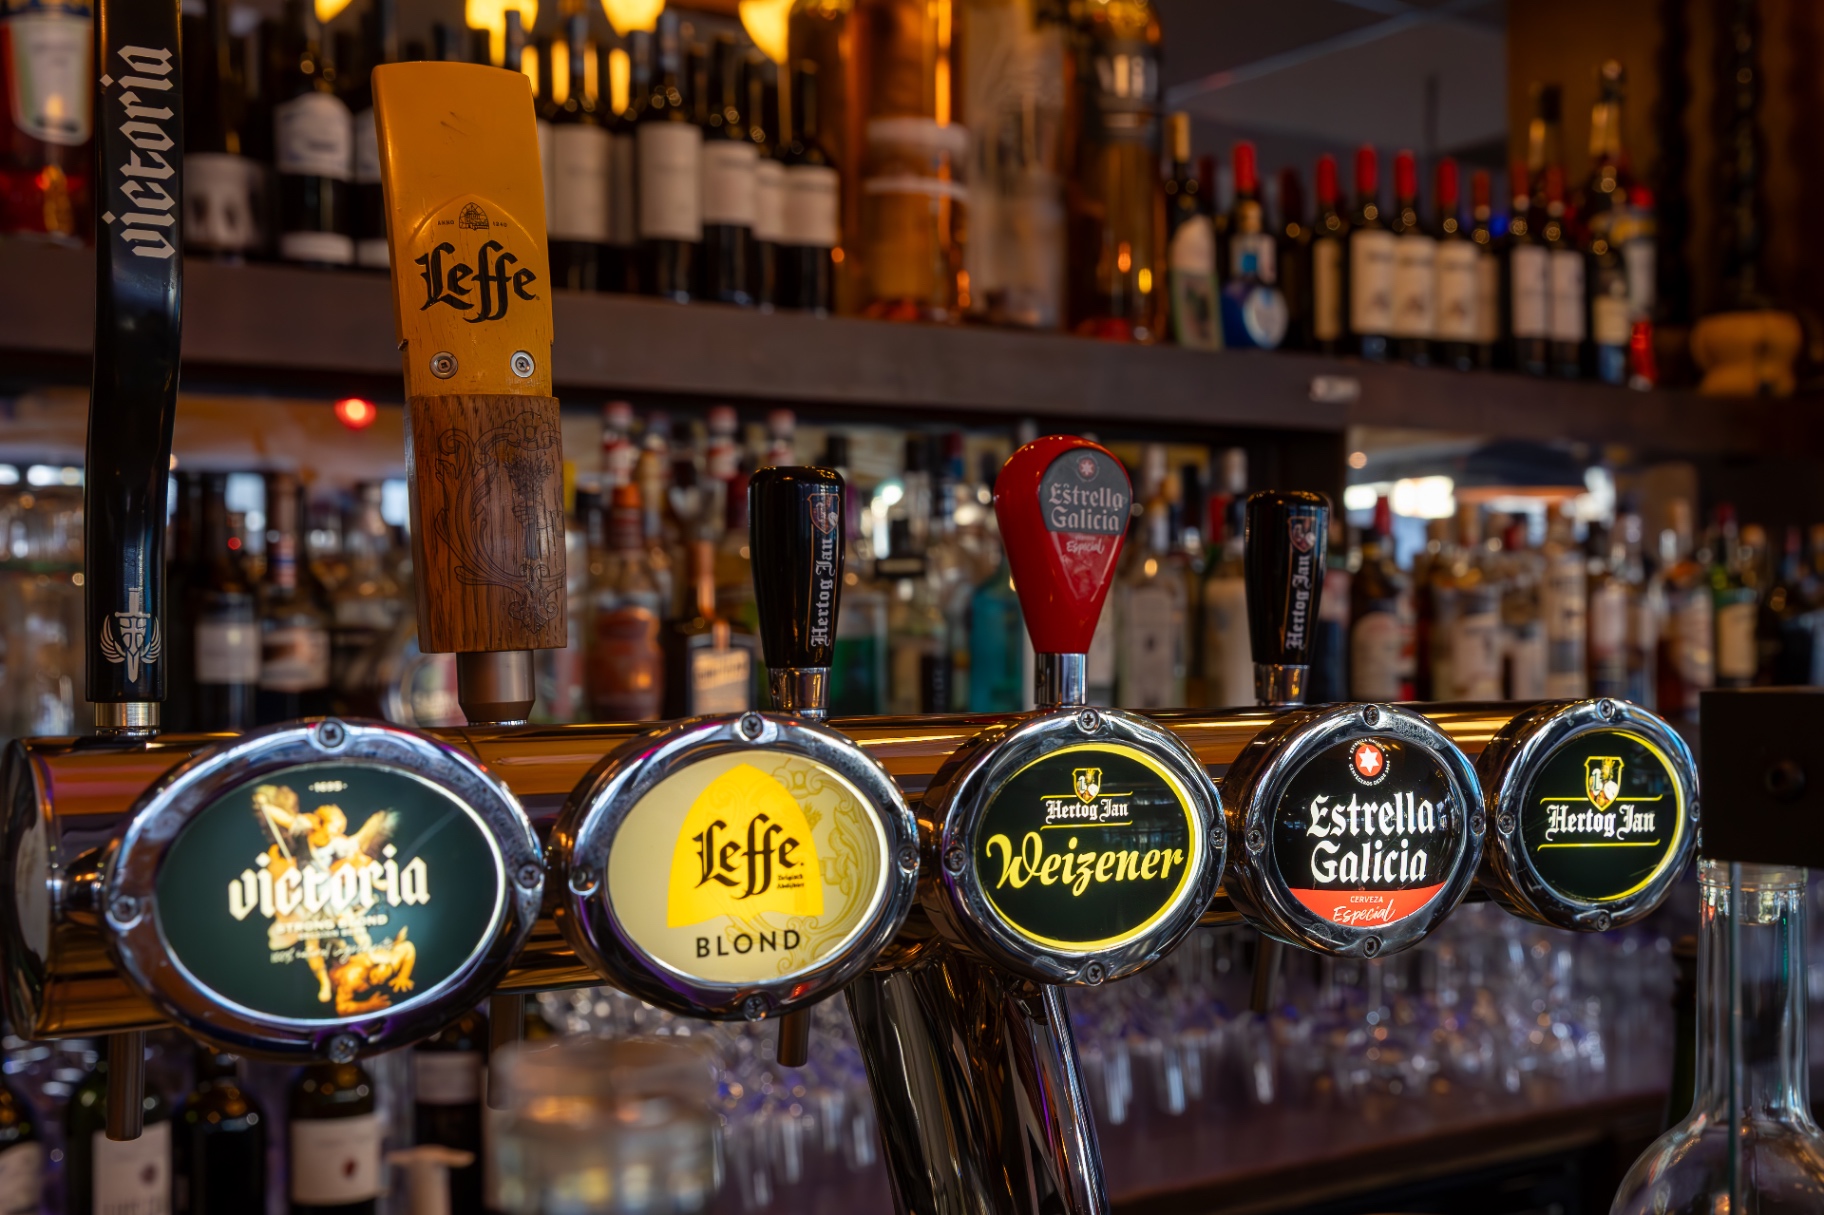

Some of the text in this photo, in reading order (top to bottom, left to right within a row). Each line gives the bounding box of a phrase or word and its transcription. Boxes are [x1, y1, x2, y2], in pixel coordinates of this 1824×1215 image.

[100, 45, 176, 259] victoria
[414, 240, 537, 323] Leffe
[1048, 482, 1124, 509] Estrella
[1051, 505, 1120, 532] Galicia
[810, 537, 836, 647] Hertog Jan
[1285, 555, 1312, 650] Hertog Jan
[1045, 799, 1129, 824] Hertog Jan
[1306, 791, 1436, 837] Estrella
[1545, 804, 1656, 841] Hertog Jan
[692, 813, 801, 900] Leffe
[986, 831, 1184, 897] Weizener
[1310, 838, 1428, 884] Galicia
[228, 843, 431, 921] victoria
[1350, 895, 1384, 904] CERVEZA
[1332, 899, 1396, 925] Especial
[696, 929, 800, 959] BLOND
